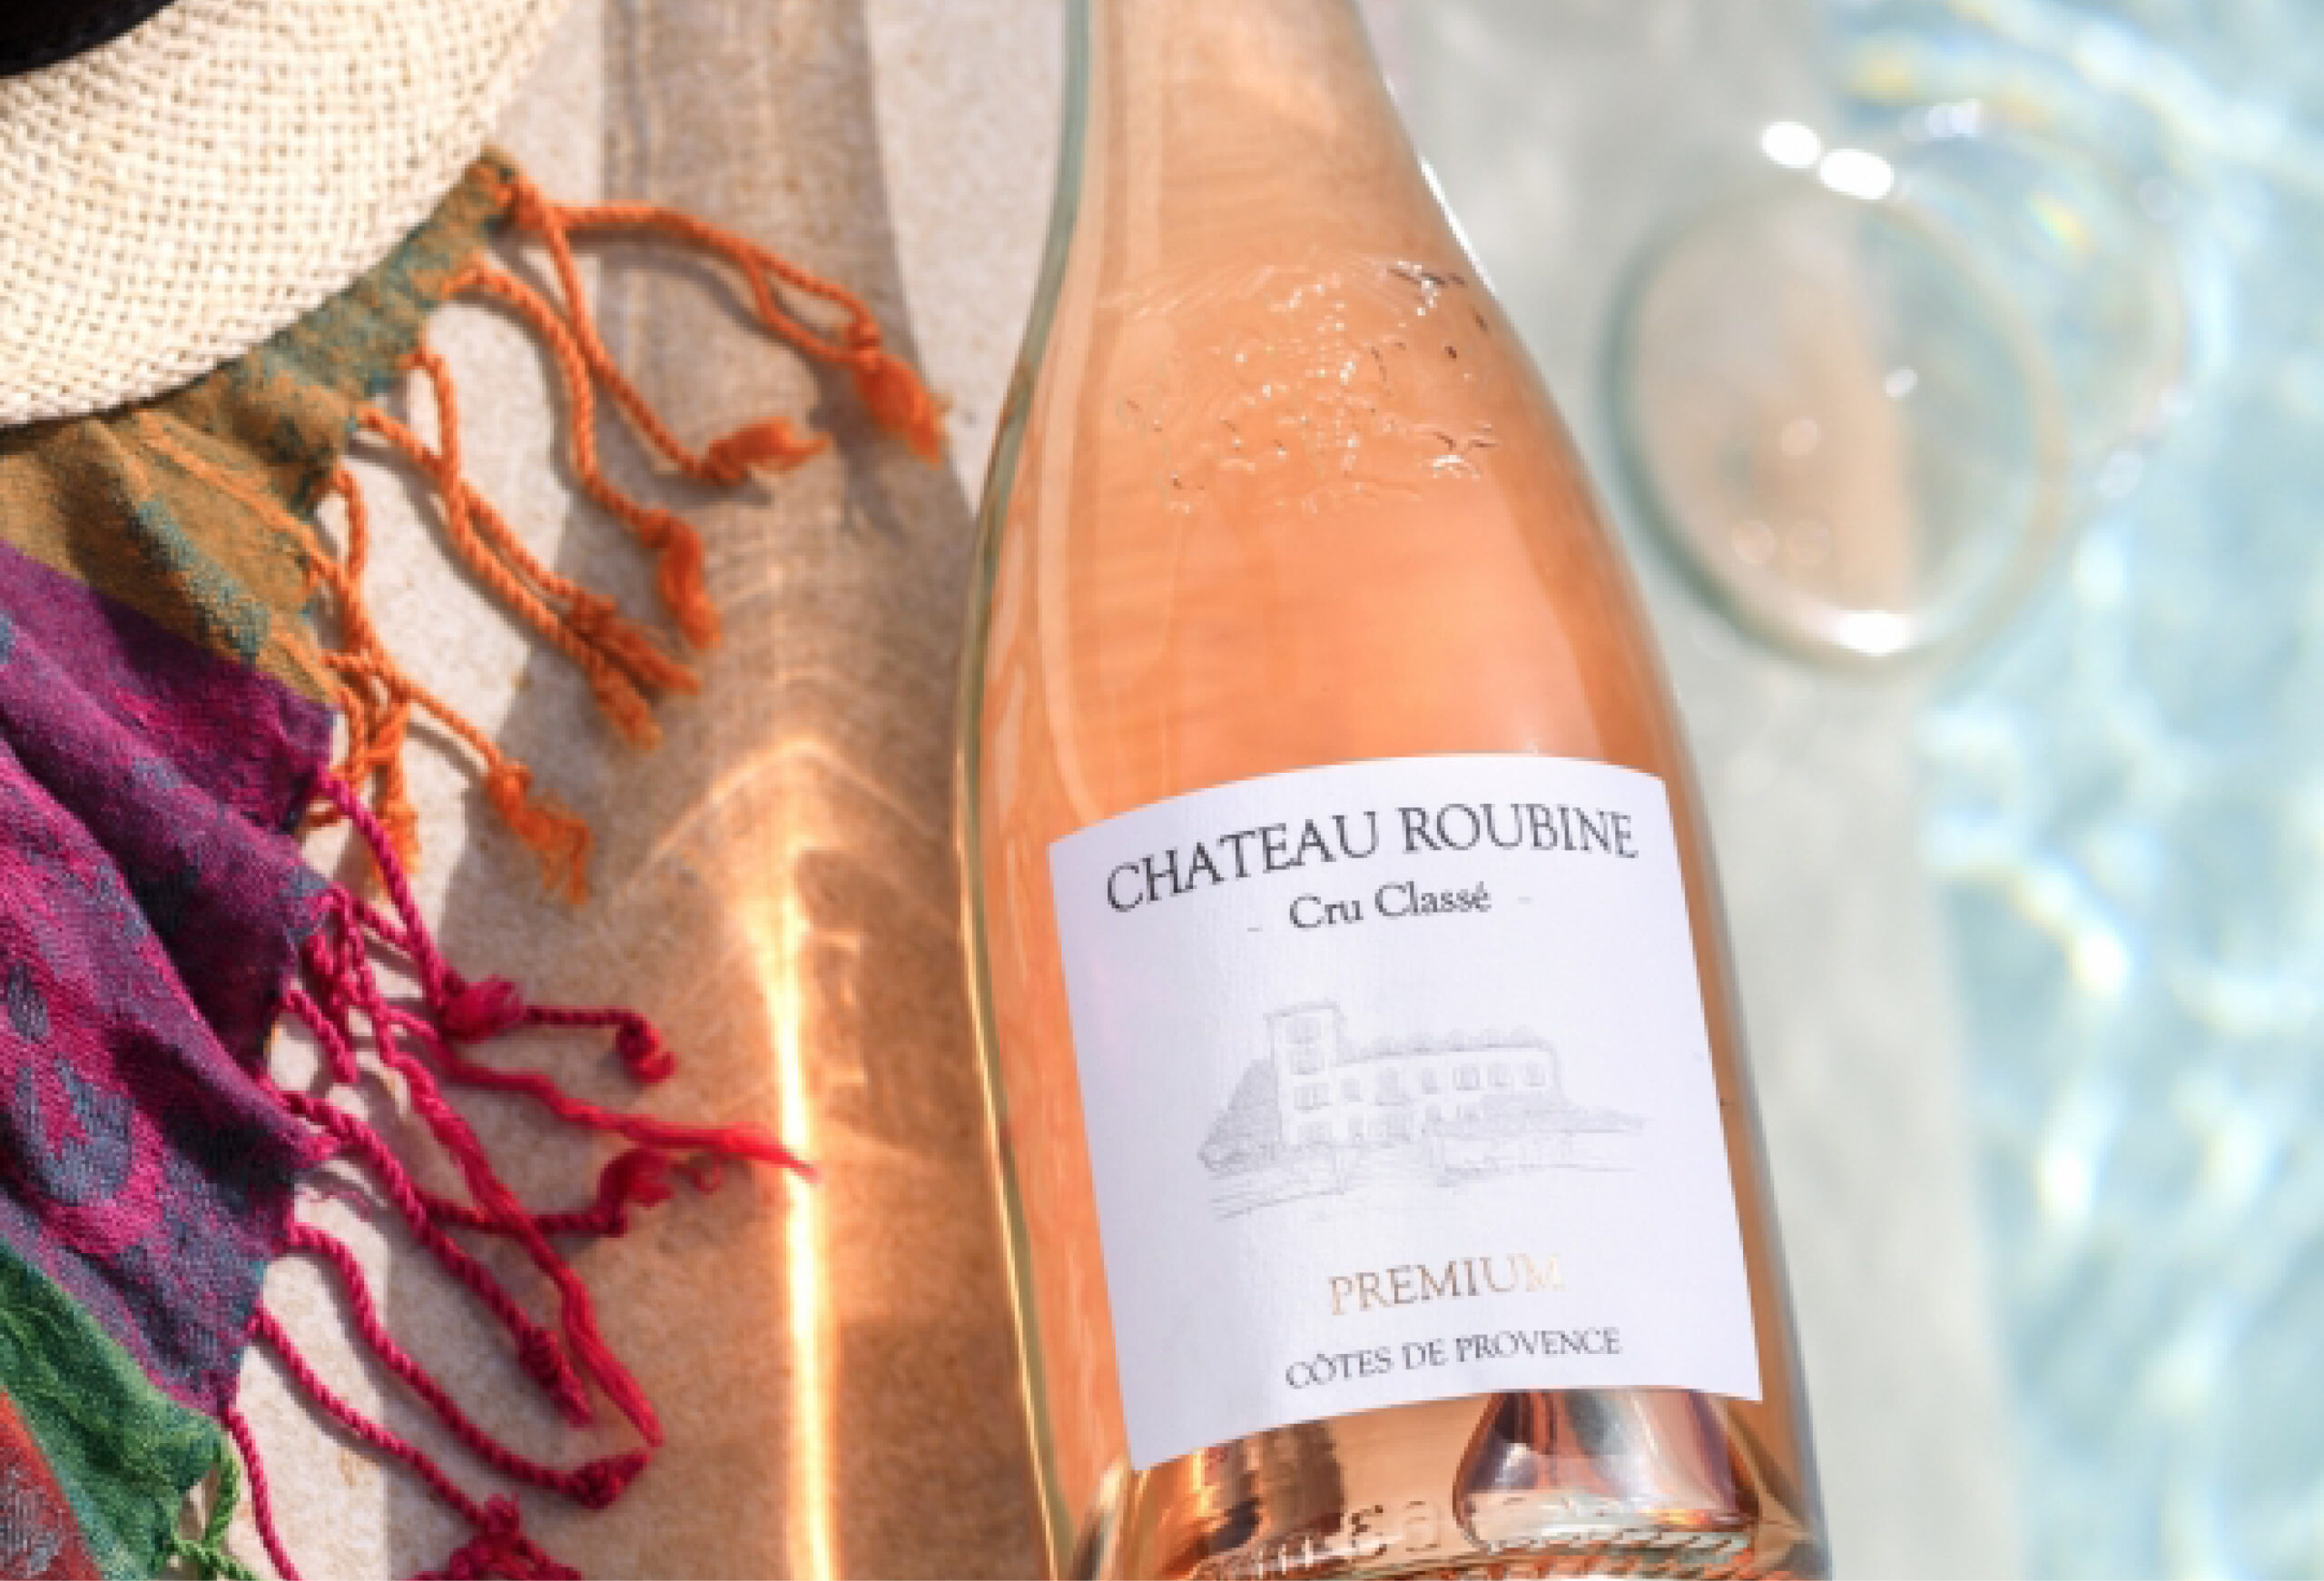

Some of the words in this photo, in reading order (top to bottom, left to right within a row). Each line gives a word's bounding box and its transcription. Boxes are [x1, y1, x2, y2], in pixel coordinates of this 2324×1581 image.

[1106, 809, 1380, 914] CHATEAU
[1396, 802, 1640, 860] ROUBINE
[1288, 894, 1364, 932] Cru
[1374, 880, 1492, 920] Classé
[1328, 1251, 1565, 1316] PREMIUM
[1285, 1345, 1394, 1389] CÔTES
[1402, 1338, 1450, 1370] DE
[1455, 1326, 1624, 1363] PROVENCE
